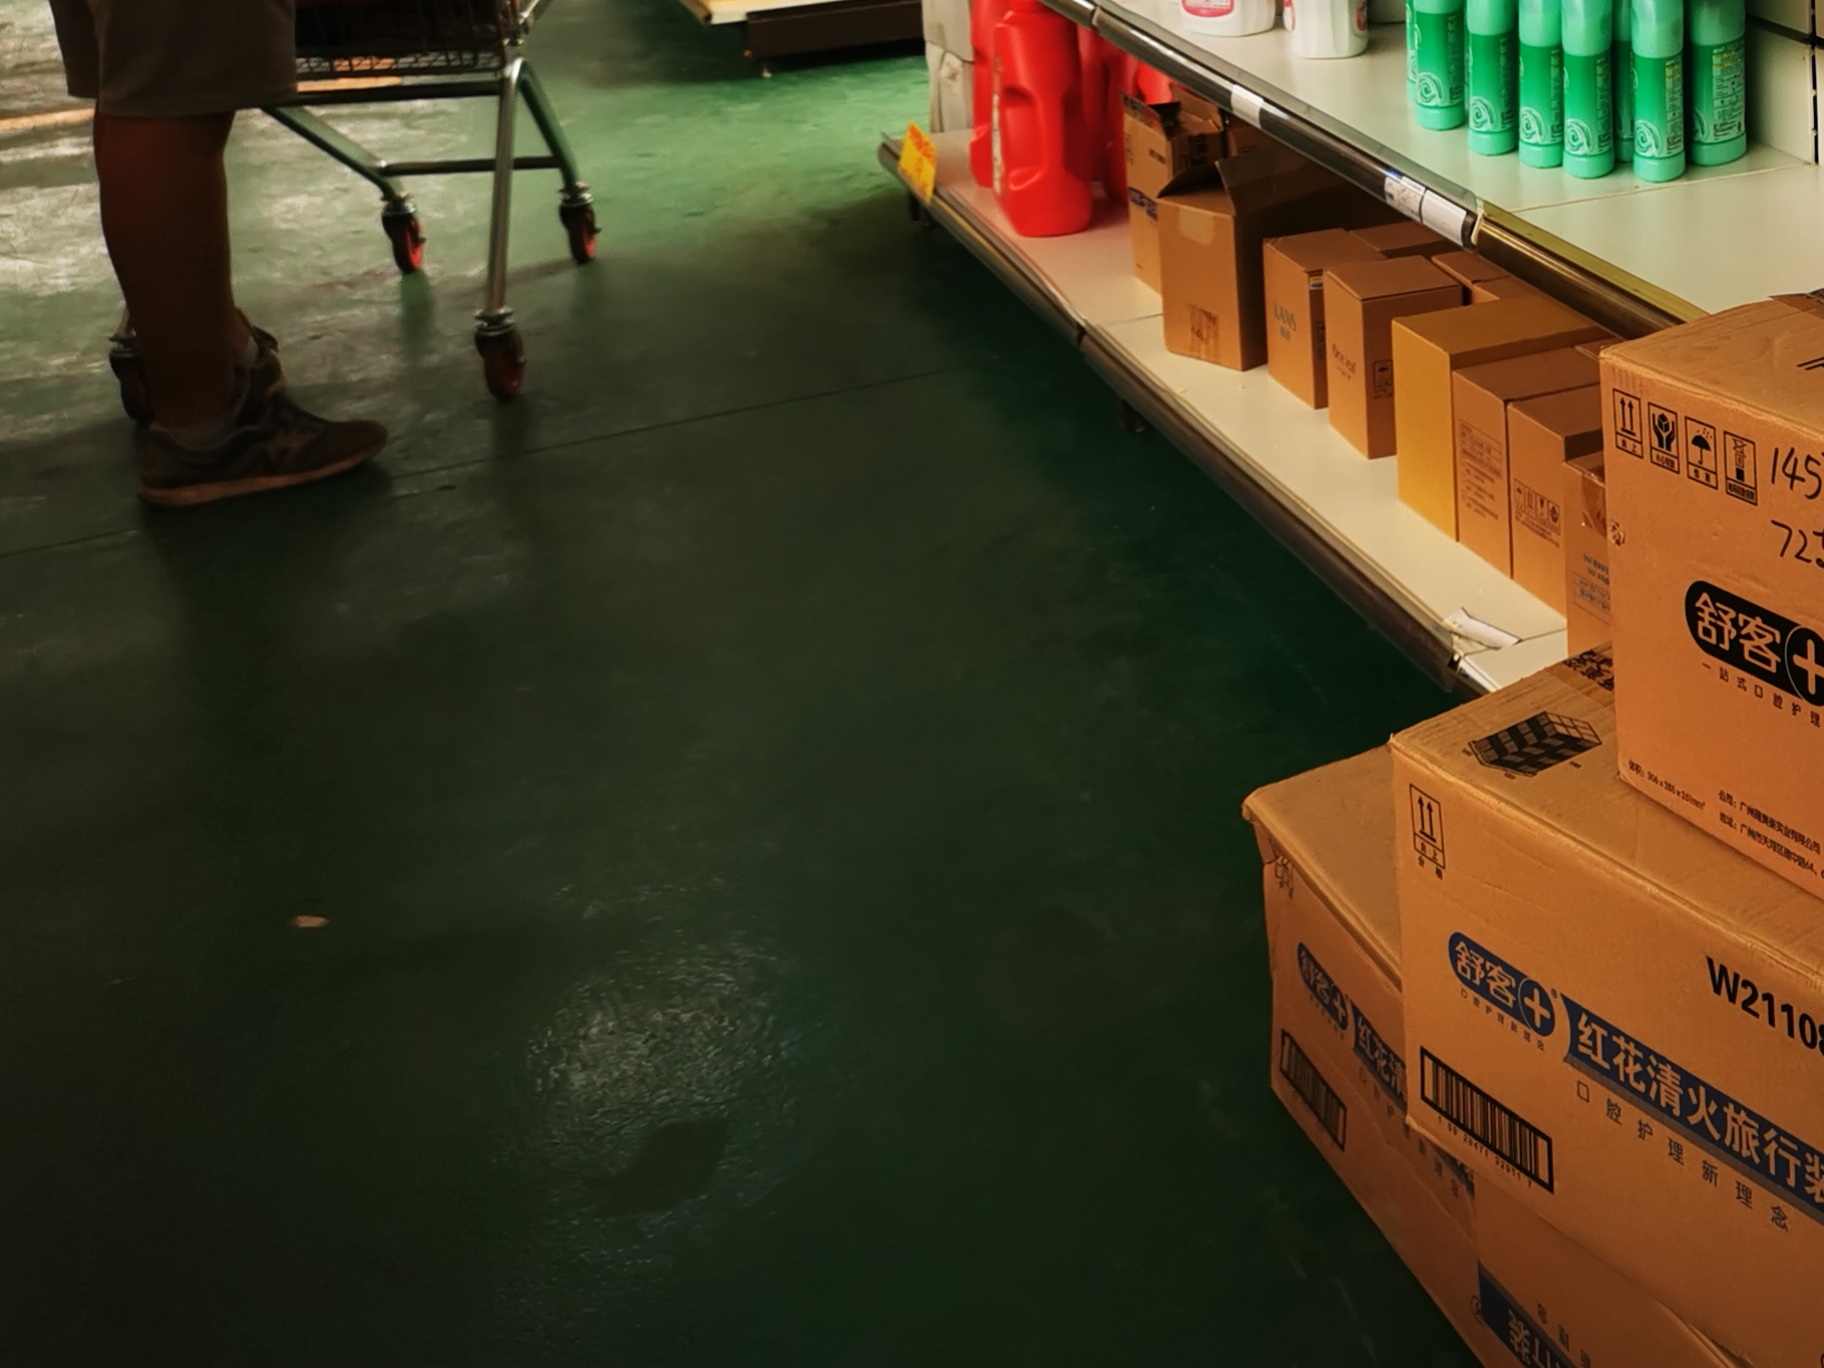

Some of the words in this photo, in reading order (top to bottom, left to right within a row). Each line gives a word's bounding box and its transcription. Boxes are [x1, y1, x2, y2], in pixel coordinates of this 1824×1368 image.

[1693, 590, 1782, 676] 舒客
[1703, 661, 1821, 729] 一站式口腔护理
[1455, 940, 1517, 1011] 舒客
[1576, 1079, 1790, 1233] 口腔护理新理念
